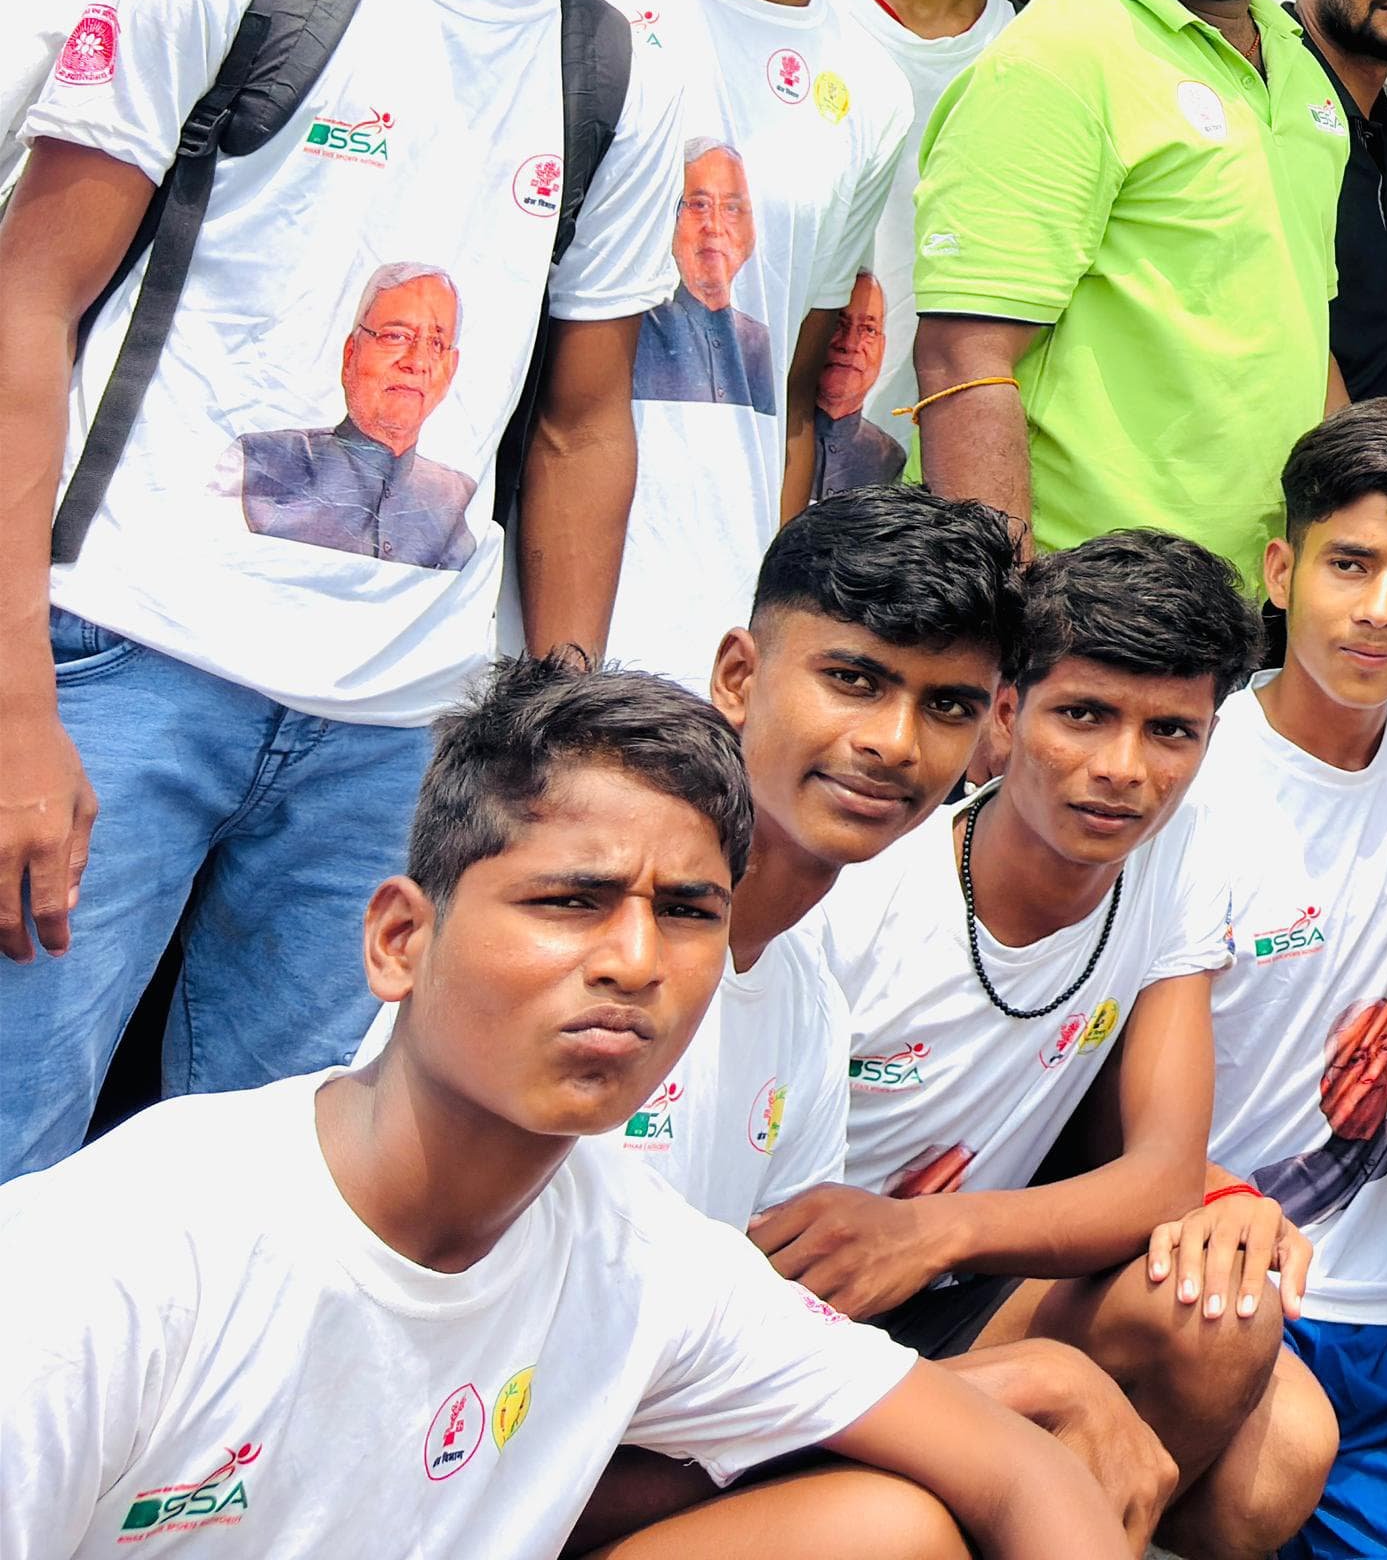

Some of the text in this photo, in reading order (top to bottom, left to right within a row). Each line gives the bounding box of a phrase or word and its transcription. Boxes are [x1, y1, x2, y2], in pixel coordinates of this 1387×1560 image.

[307, 123, 388, 160] BSSA
[1255, 927, 1325, 957] BSSA
[121, 1480, 248, 1530] BSSA
